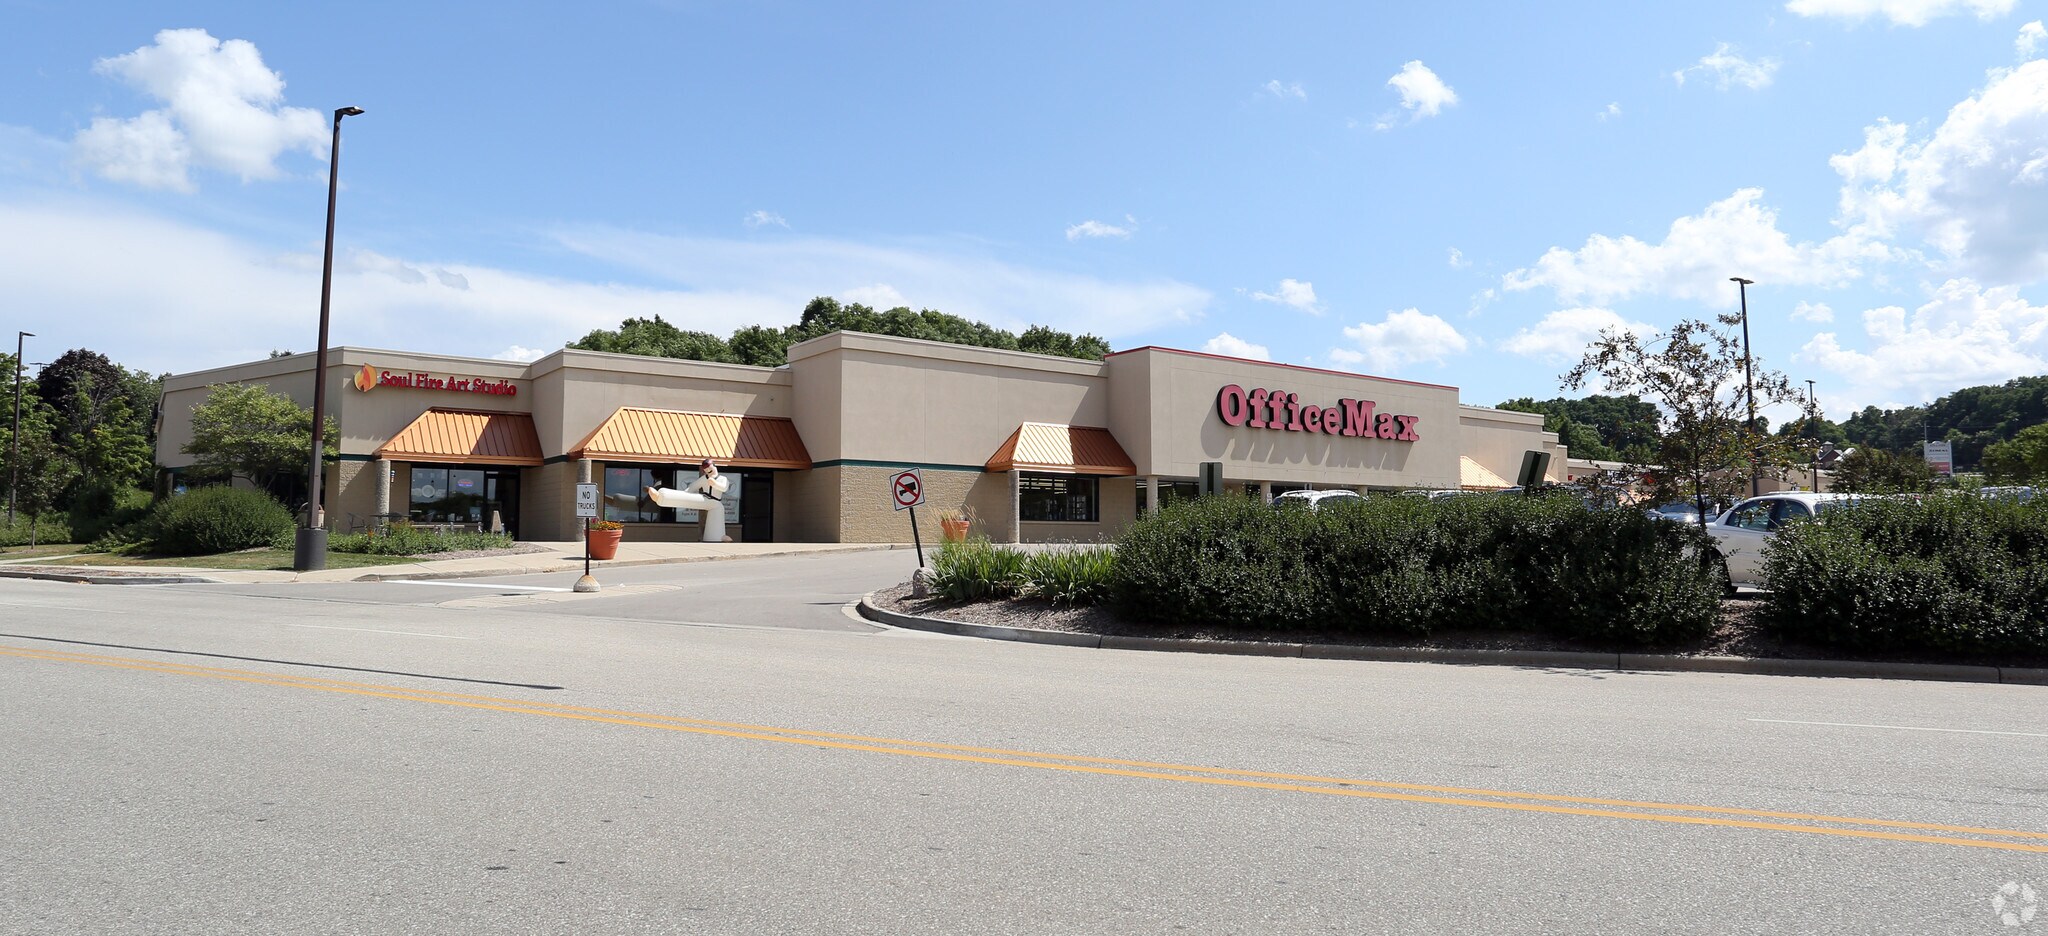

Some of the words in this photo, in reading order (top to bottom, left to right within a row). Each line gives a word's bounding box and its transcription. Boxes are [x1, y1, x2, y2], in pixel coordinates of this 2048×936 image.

[381, 370, 412, 388] Soul
[416, 373, 444, 390] Fire
[446, 376, 470, 392] Art
[473, 378, 517, 396] Studio
[1217, 384, 1420, 441] OfficeMax
[582, 491, 591, 500] NO
[577, 502, 596, 510] TRUCKS
